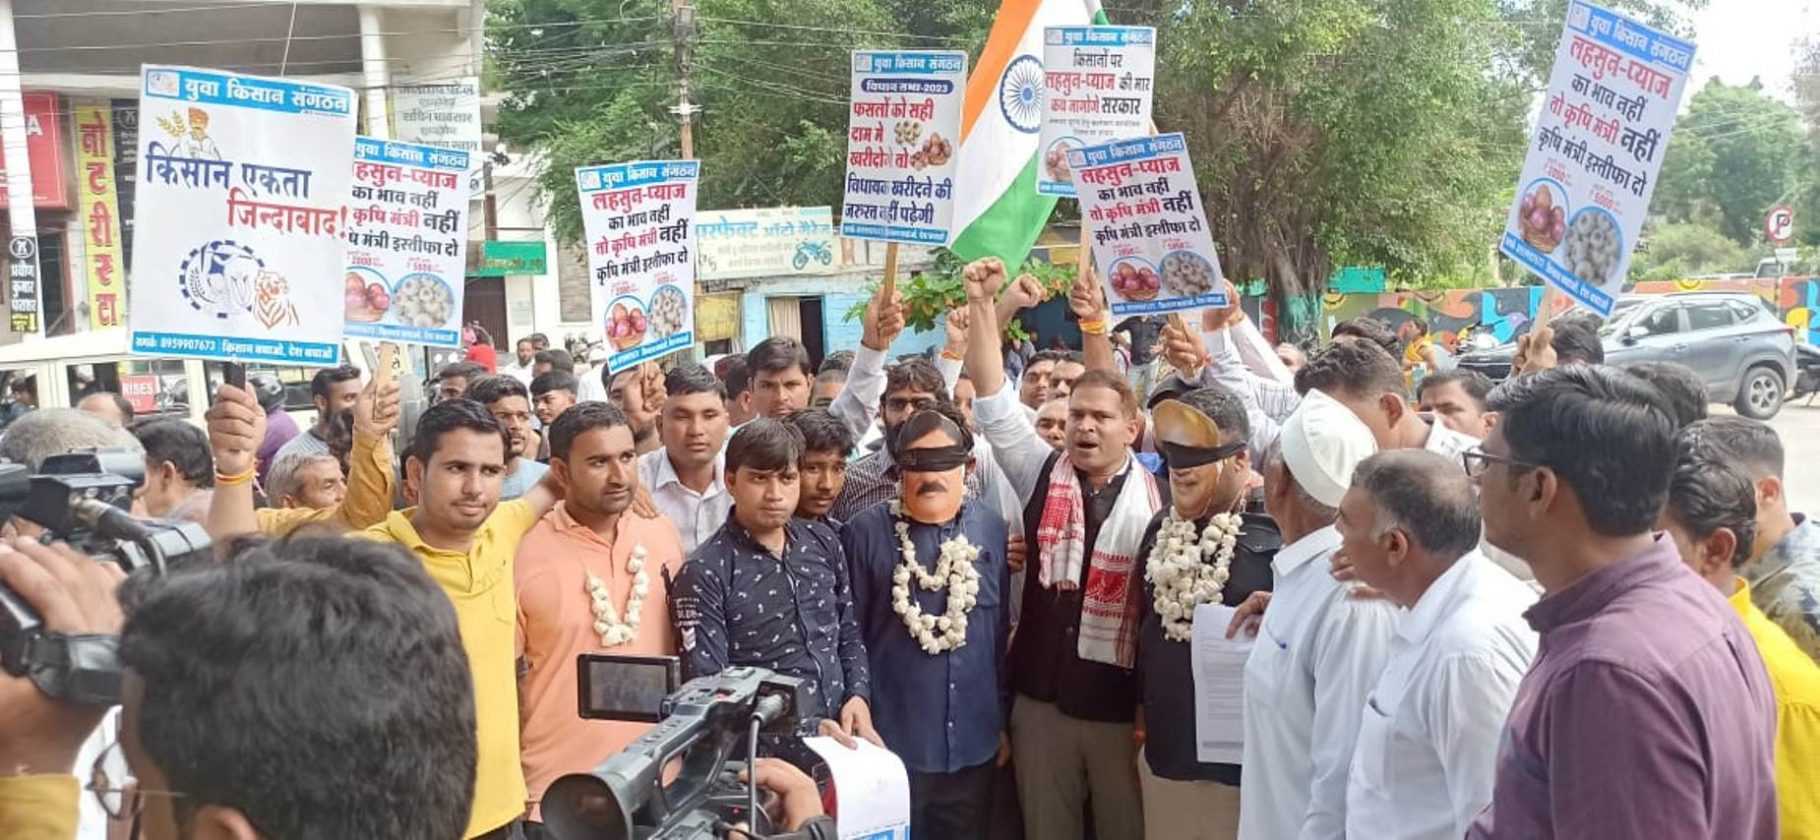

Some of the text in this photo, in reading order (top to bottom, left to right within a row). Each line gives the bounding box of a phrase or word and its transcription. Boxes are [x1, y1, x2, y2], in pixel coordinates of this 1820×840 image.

[1065, 32, 1084, 45] युवा
[1086, 29, 1119, 42] किसान
[1590, 15, 1691, 70] युवा किसान संगठन
[874, 54, 961, 72] युवा किसान संगठन
[1110, 54, 1123, 68] पर
[1570, 35, 1673, 100] लहसुन-प्याज
[185, 78, 349, 112] युवा किसान संगठन
[1044, 71, 1150, 97] लहसुन-प्याज की मार
[854, 95, 934, 121] फसलों को सही
[1051, 94, 1141, 114] कब जागोगे सरकार
[1571, 73, 1649, 123] का भाव नहीं
[851, 126, 873, 142] दाम
[1550, 91, 1662, 162] तो कृषि मंत्री नहीं
[355, 142, 468, 168] युवा किसान संगठन
[895, 146, 910, 169] तो
[1089, 139, 1183, 165] युवा किसान संगठन
[1539, 126, 1647, 197] कृषि मंत्री इस्तीफा दो
[146, 141, 234, 189] किसान
[241, 162, 312, 198] एकता
[354, 161, 459, 189] हसुन-प्याज
[601, 164, 695, 189] युवा किसान संगठन
[1080, 157, 1182, 187] लहसुन-प्याज
[352, 185, 440, 209] का भाव नहीं
[591, 182, 688, 213] लहसुन-प्याज
[891, 174, 934, 198] खरीदने
[935, 177, 952, 200] की
[1097, 176, 1171, 201] का भाव नहीं
[227, 186, 348, 239] जिन्दाबाद!
[354, 204, 461, 234] कृषि मंत्री नहीं
[608, 203, 671, 230] का भाव नहीं
[879, 200, 900, 223] नहीं
[1089, 190, 1193, 223] तो कृषि मंत्री नहीं
[594, 217, 690, 257] तो कृषि मंत्री नहीं
[1094, 214, 1202, 246] कृषि मंत्री इस्तीफा दो
[1776, 213, 1790, 235] P
[362, 229, 390, 250] मंत्री
[392, 234, 442, 255] इस्तीफा
[445, 237, 458, 257] दो
[596, 259, 619, 286] कृषि
[621, 255, 641, 275] मंत्री
[643, 250, 676, 272] इस्तीफा
[677, 245, 689, 263] दो
[11, 281, 35, 297] कुमार
[160, 337, 216, 352] 8959907673
